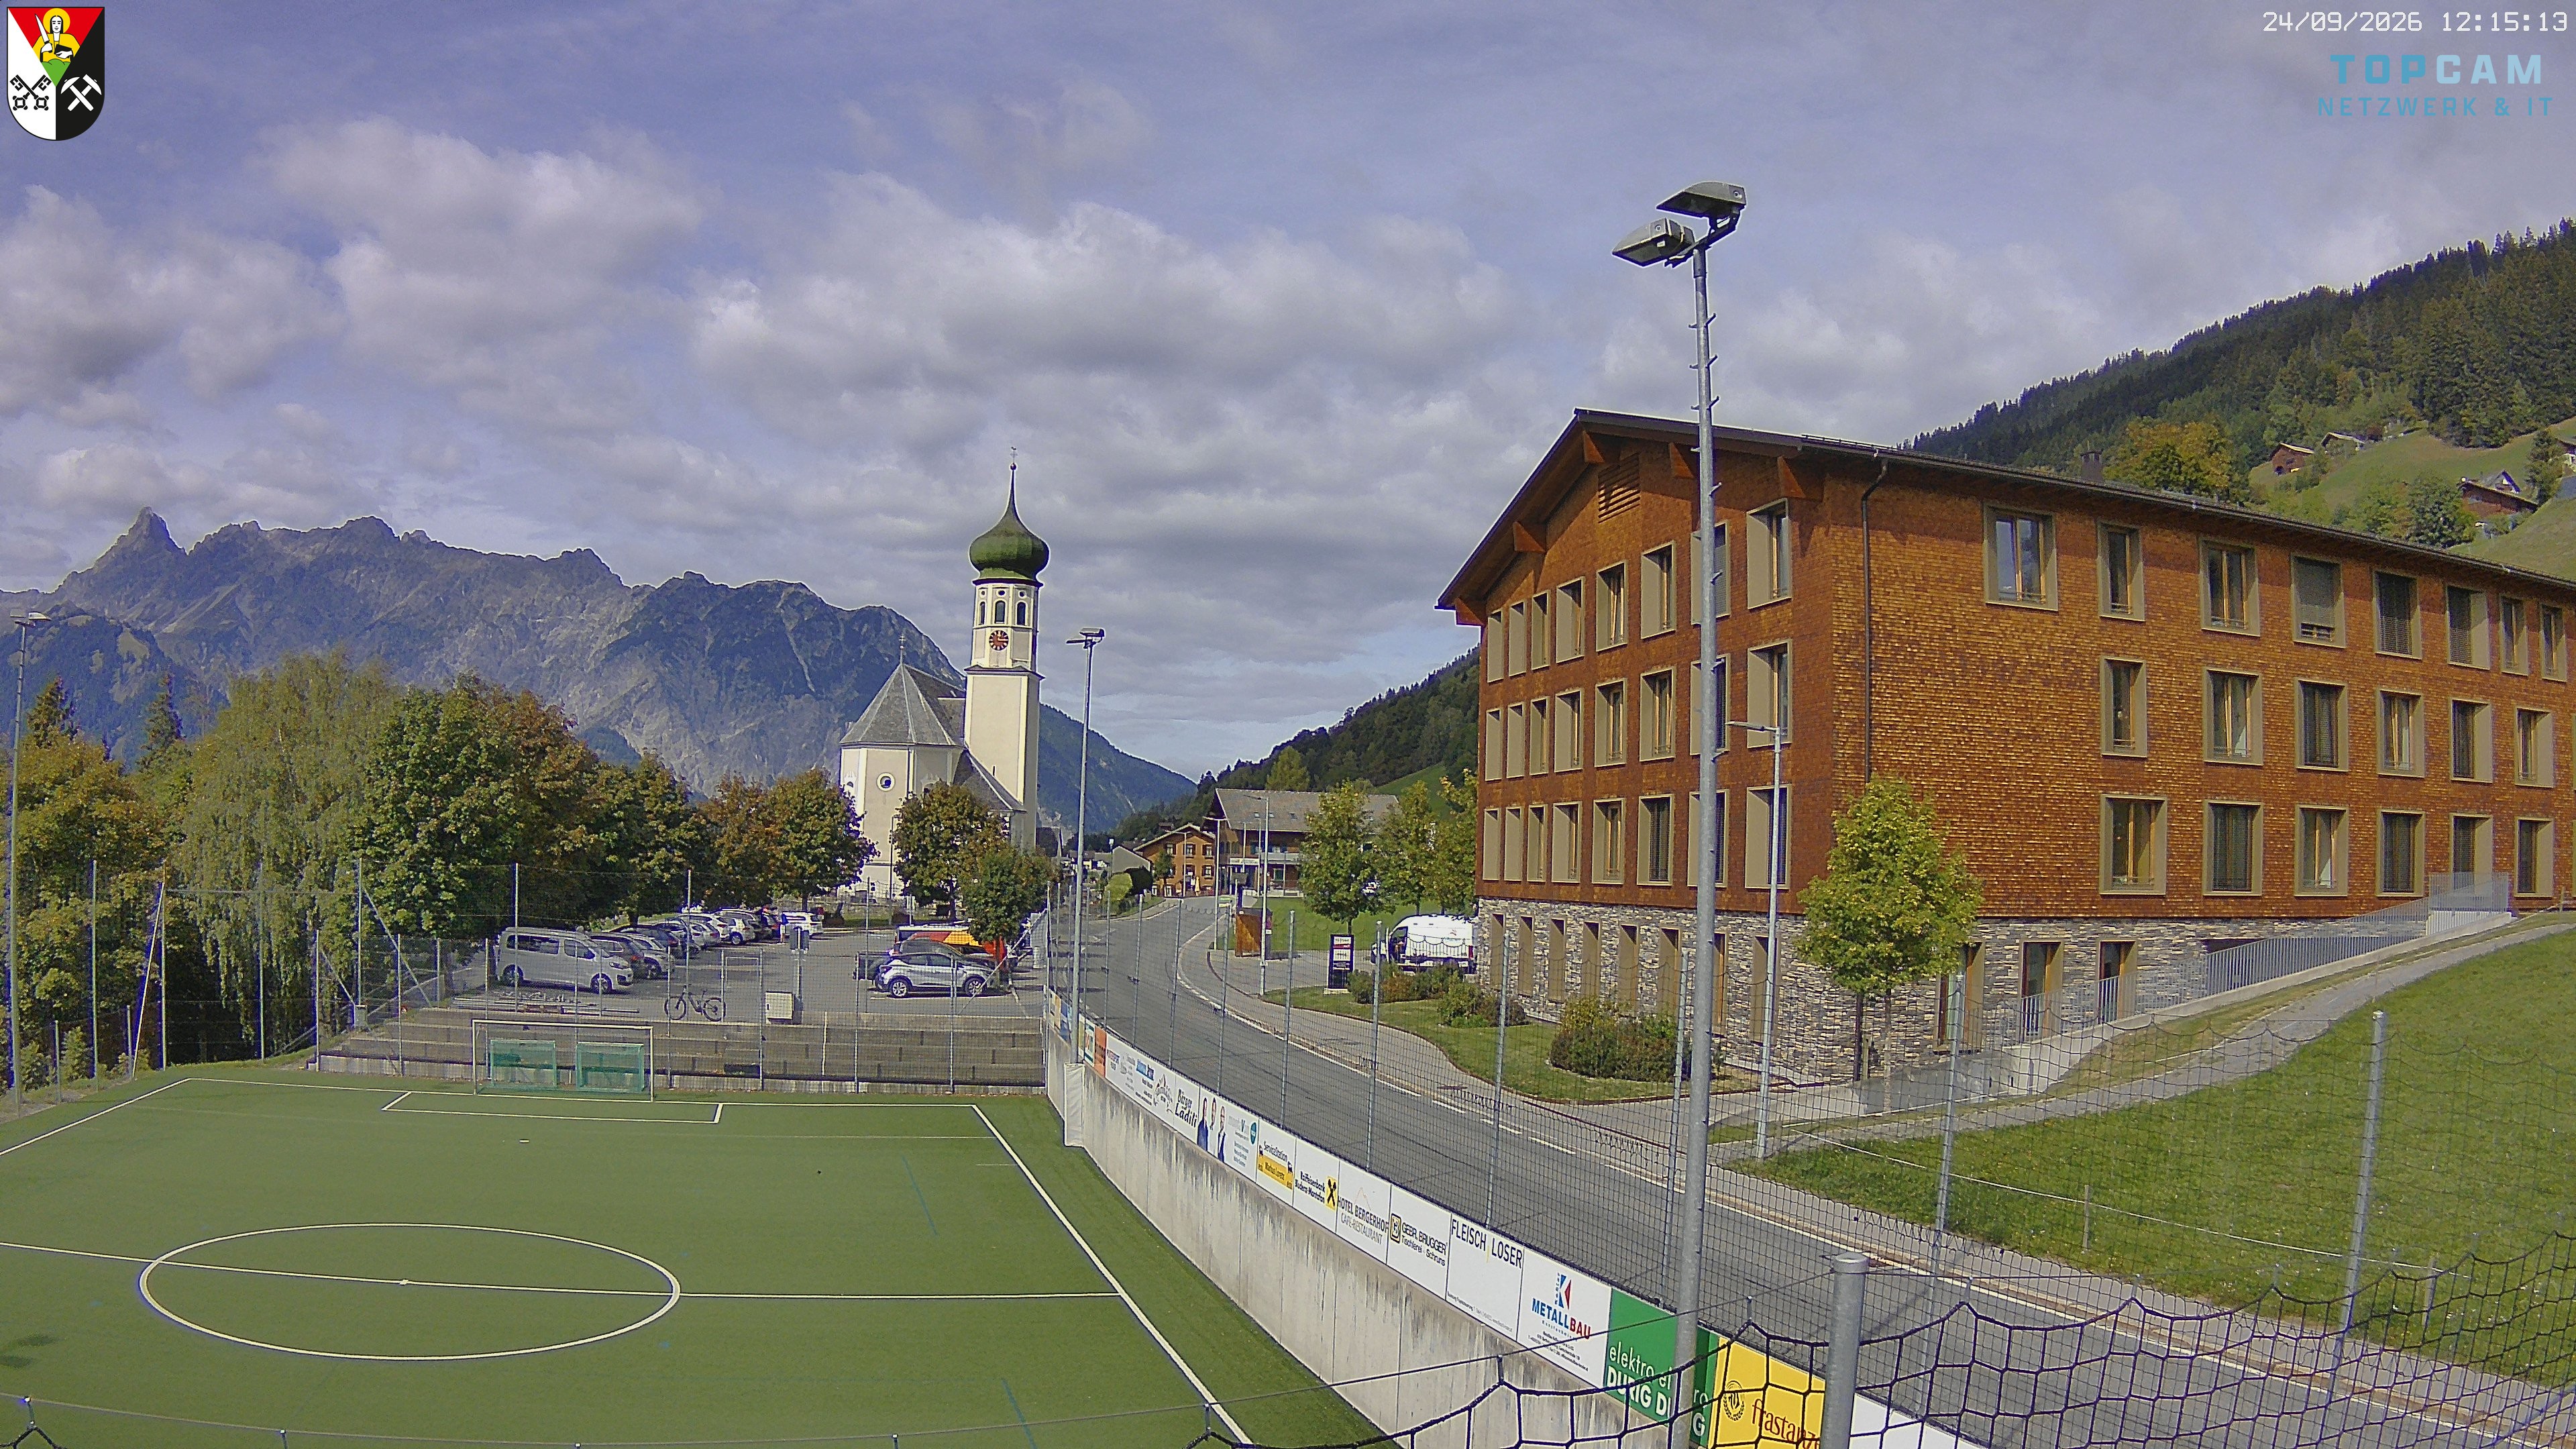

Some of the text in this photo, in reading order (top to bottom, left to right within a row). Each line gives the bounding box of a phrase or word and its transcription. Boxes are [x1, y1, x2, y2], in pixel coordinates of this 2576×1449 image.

[1338, 1195, 1354, 1215] HOTEL
[1355, 1205, 1389, 1234] BERGERHOF
[1401, 1234, 1446, 1266] Tischlerei Schruns
[1402, 1222, 1417, 1240] GEBR.
[1419, 1231, 1447, 1255] BRUGGER
[1451, 1218, 1523, 1269] FLEISCH LOSER
[1532, 1297, 1591, 1340] METALLBAU
[1609, 1341, 1654, 1379] elektro
